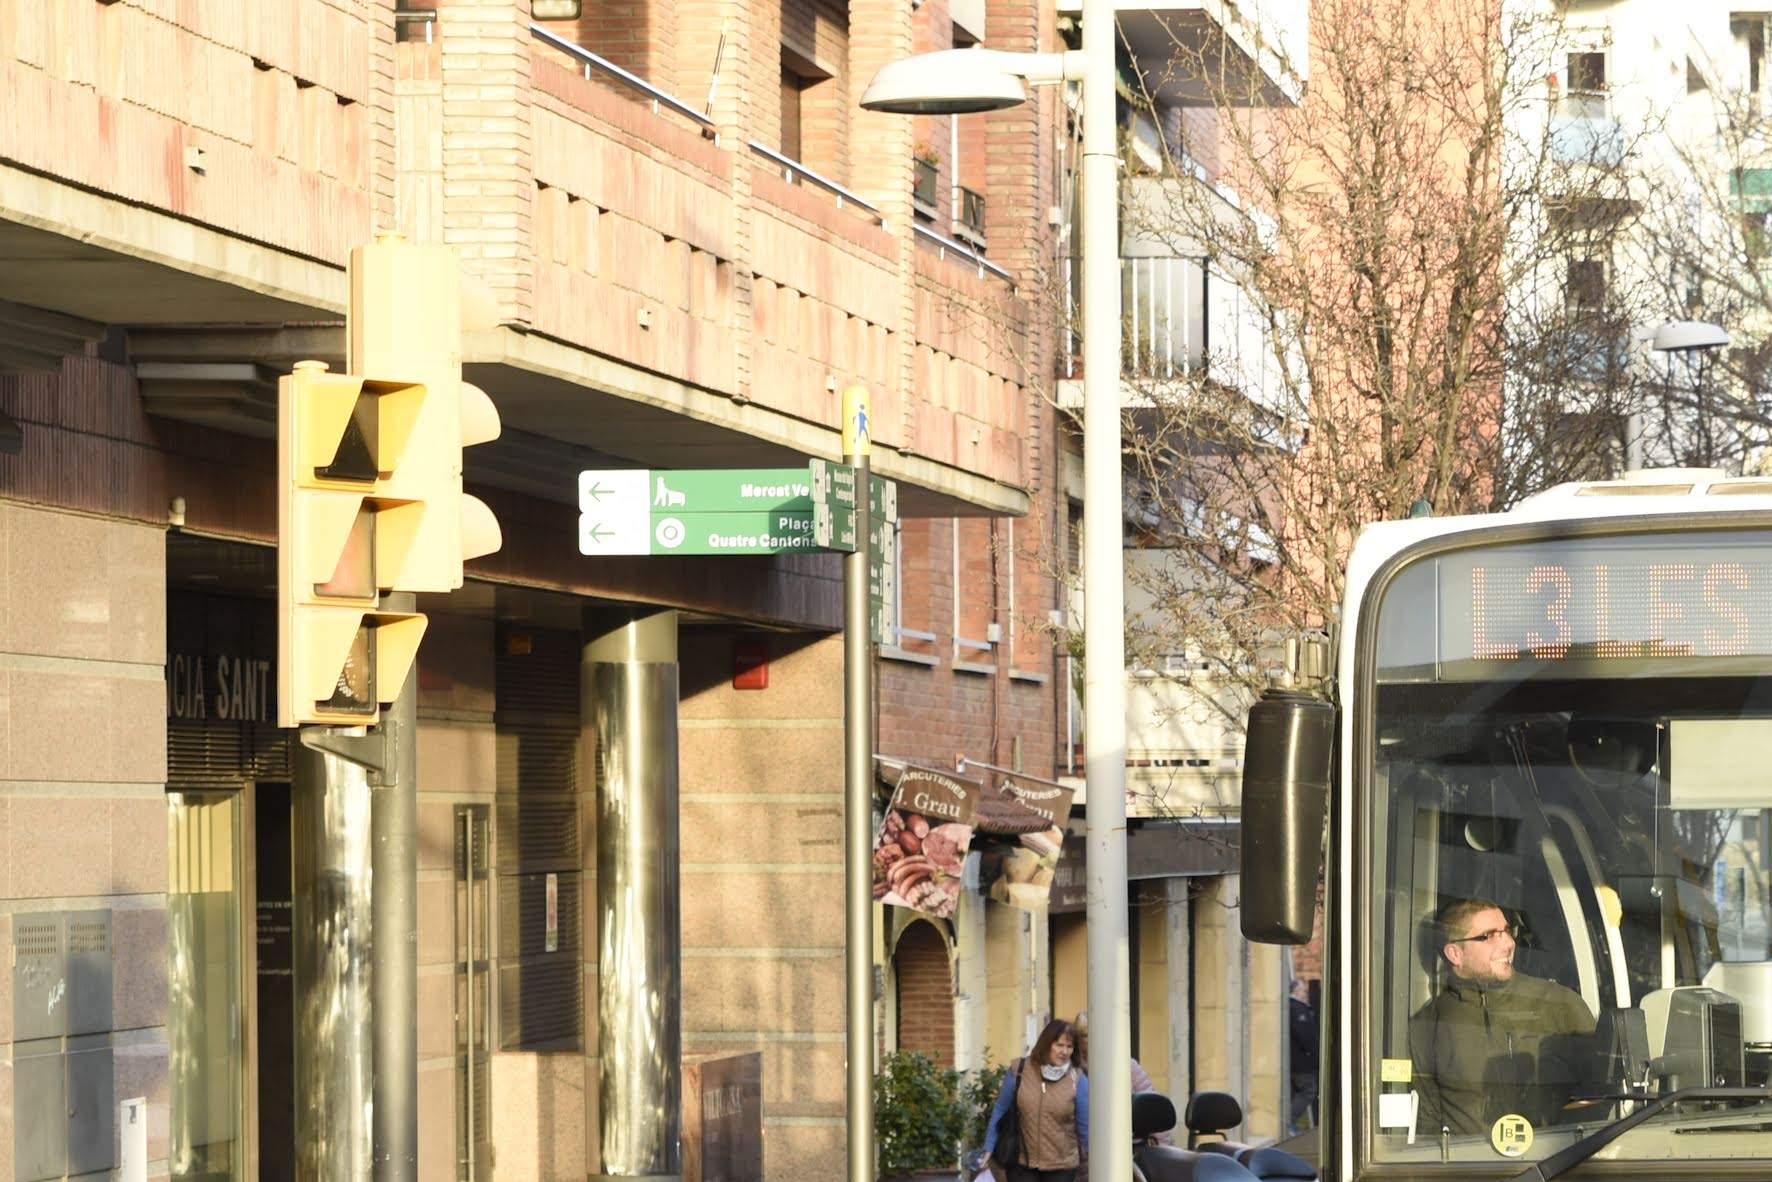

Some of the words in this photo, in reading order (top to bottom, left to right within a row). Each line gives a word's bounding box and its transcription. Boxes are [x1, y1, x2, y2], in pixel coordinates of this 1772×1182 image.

[741, 483, 790, 498] Mercat
[779, 517, 817, 533] Plaça
[708, 533, 757, 548] Quatre
[759, 533, 817, 548] Cantons
[217, 655, 269, 722] SANT
[914, 792, 960, 818] Grau
